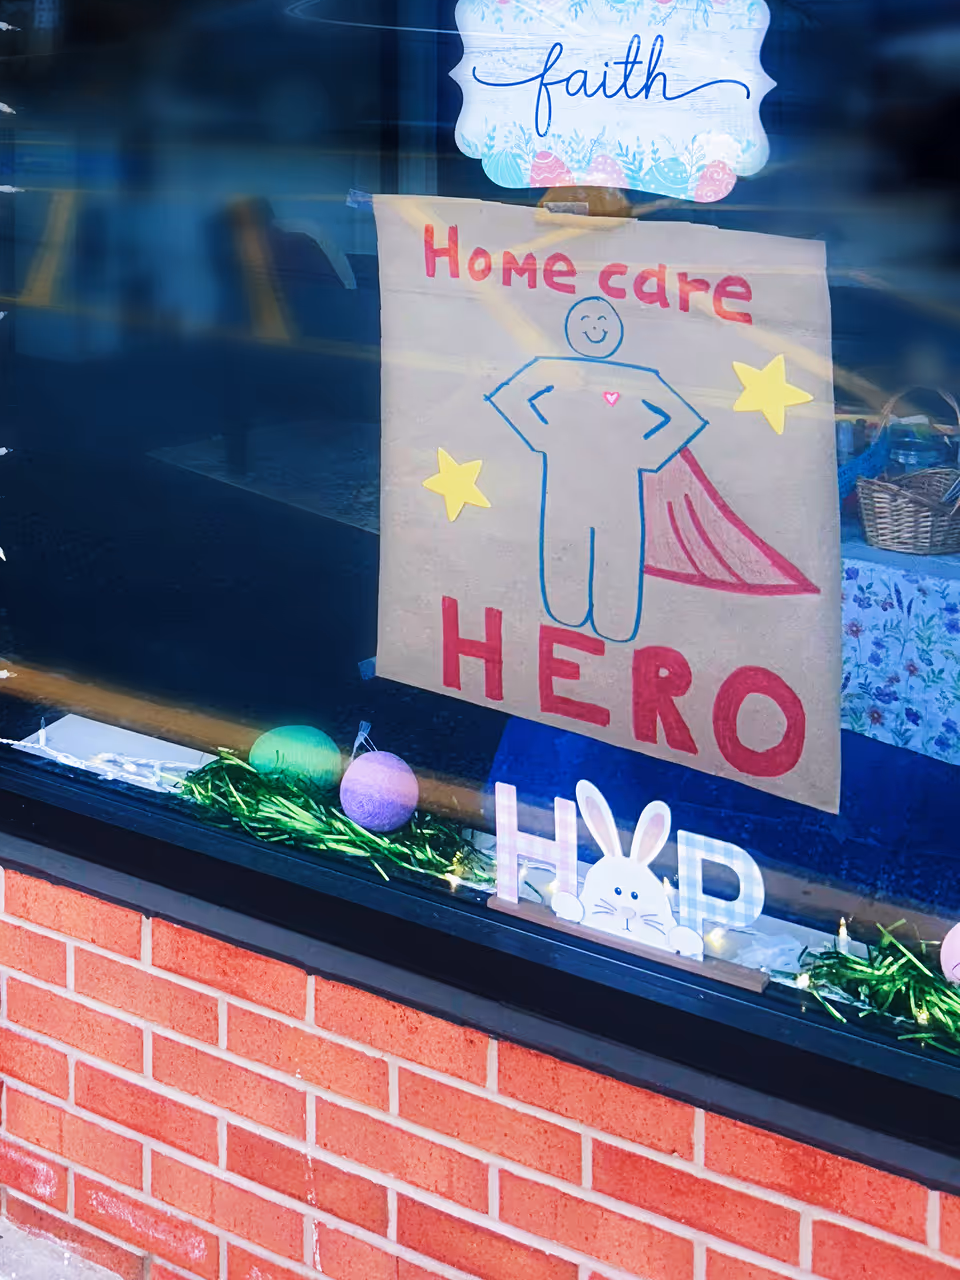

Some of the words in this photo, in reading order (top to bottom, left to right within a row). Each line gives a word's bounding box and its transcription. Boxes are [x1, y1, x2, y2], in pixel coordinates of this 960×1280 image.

[472, 34, 751, 138] faith
[423, 223, 577, 294] Home
[598, 262, 754, 326] care
[441, 595, 807, 778] HERO
